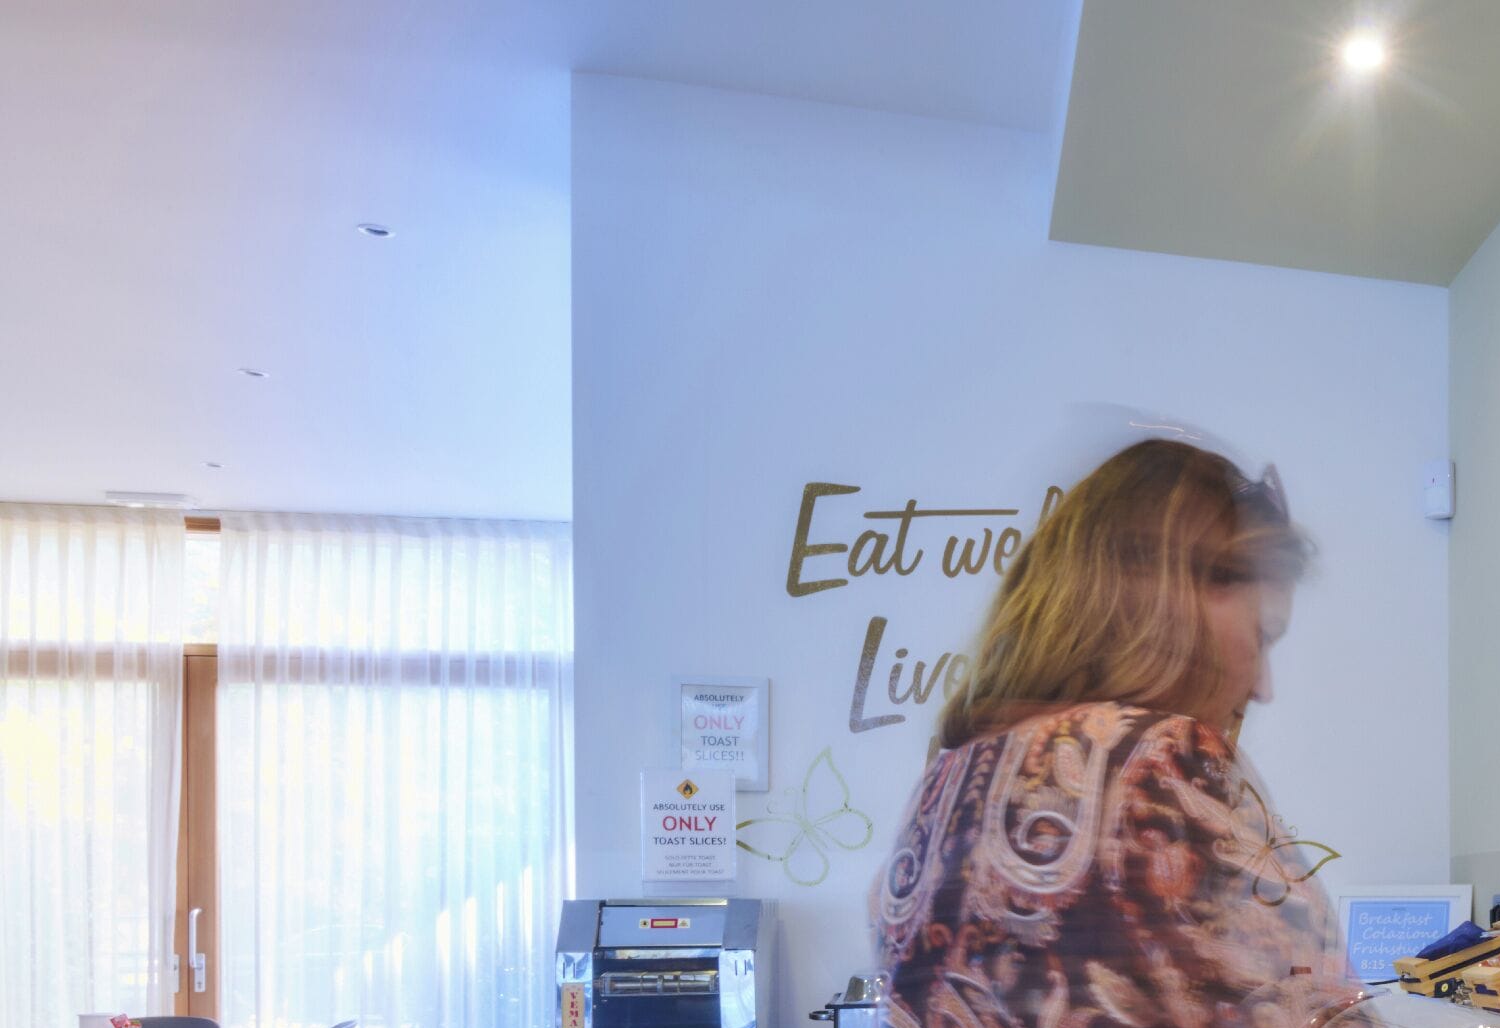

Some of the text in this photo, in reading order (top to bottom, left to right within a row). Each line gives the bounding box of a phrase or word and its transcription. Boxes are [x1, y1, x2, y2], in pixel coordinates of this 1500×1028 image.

[786, 482, 1019, 598] Eat
[694, 694, 744, 702] ABSOLUTELY
[694, 714, 744, 730] ONLY
[700, 735, 740, 747] TOAST
[695, 750, 744, 761] SLICES!!
[653, 803, 707, 811] ABSOLUTELY
[662, 815, 717, 831] ONLY
[653, 837, 727, 846] TOAST SLICES!
[1358, 912, 1433, 927] Breakfast
[1361, 927, 1441, 940] Colazione
[1360, 959, 1385, 970] 8:15
